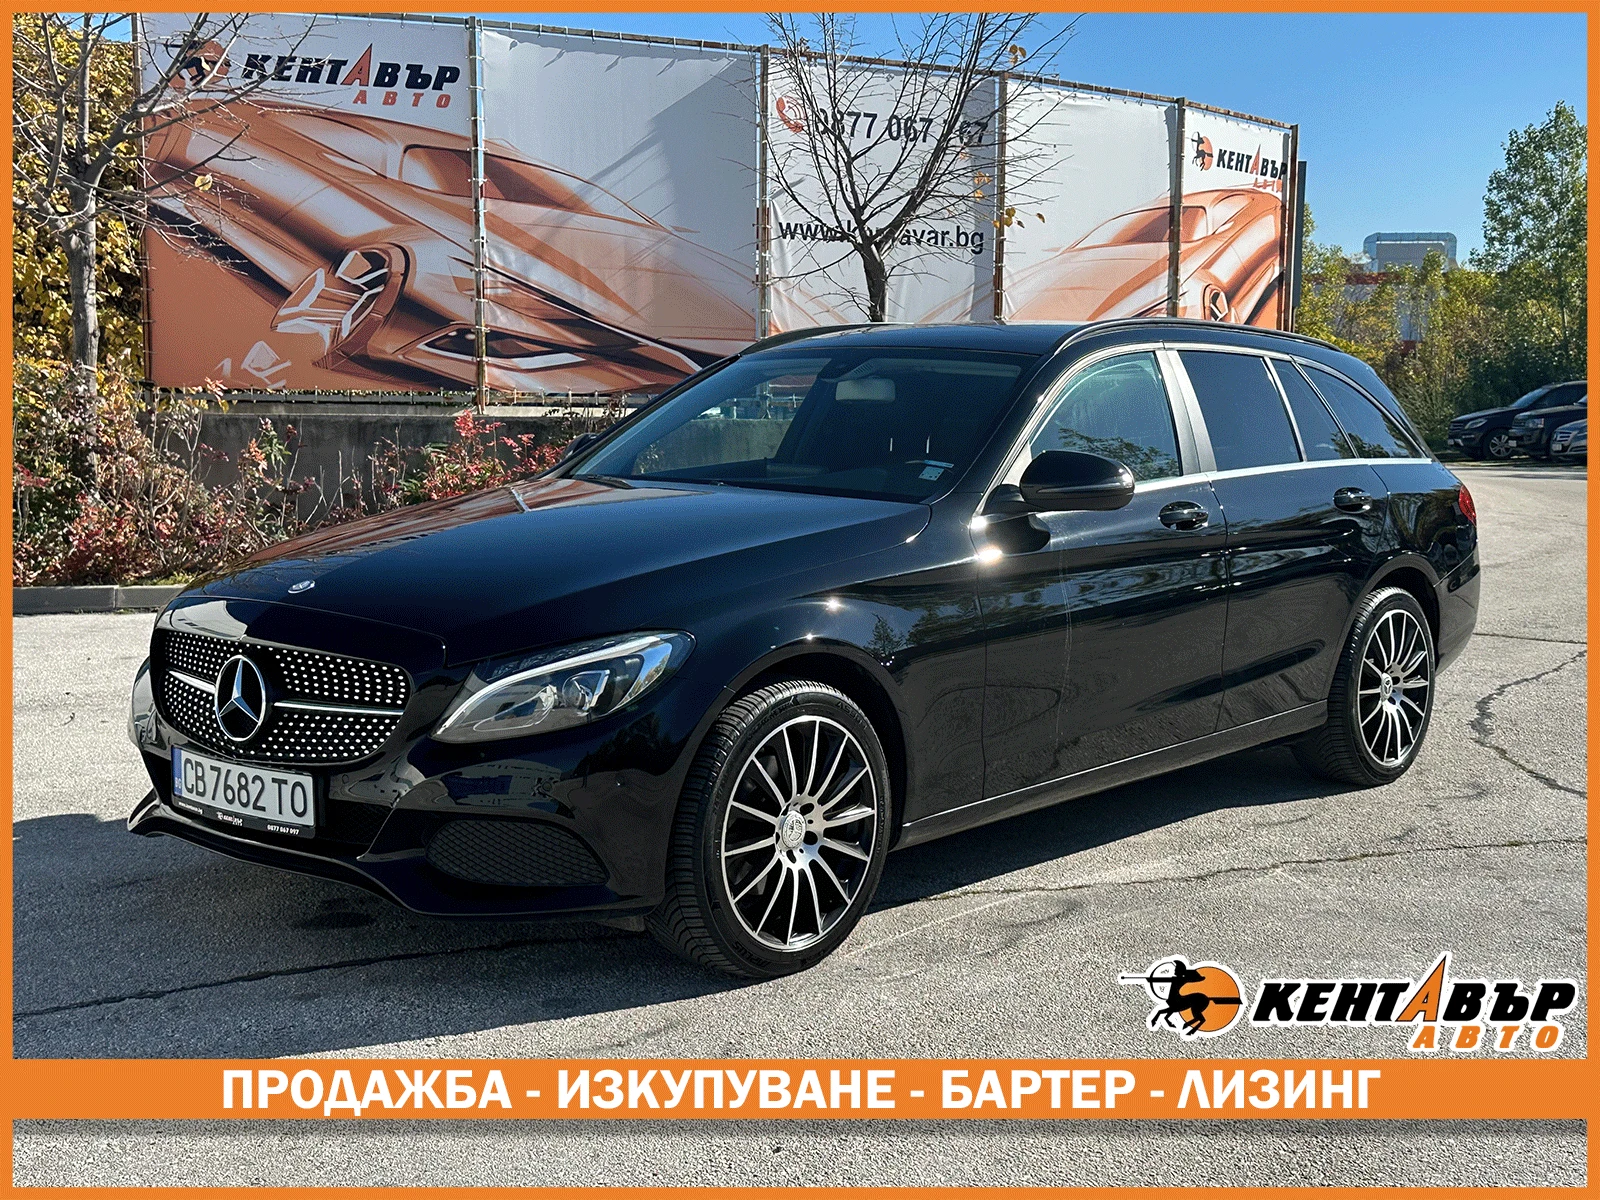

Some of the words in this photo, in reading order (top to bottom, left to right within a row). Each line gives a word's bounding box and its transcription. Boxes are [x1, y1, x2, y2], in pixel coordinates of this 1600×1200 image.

[241, 43, 461, 91] КЕНТАВЪР
[352, 89, 451, 109] АВТО
[888, 114, 934, 143] 067
[942, 119, 989, 144] 67
[1216, 144, 1288, 180] КЕНТАВЪР
[778, 219, 984, 254] www.kavar.bg
[209, 764, 267, 812] 7682
